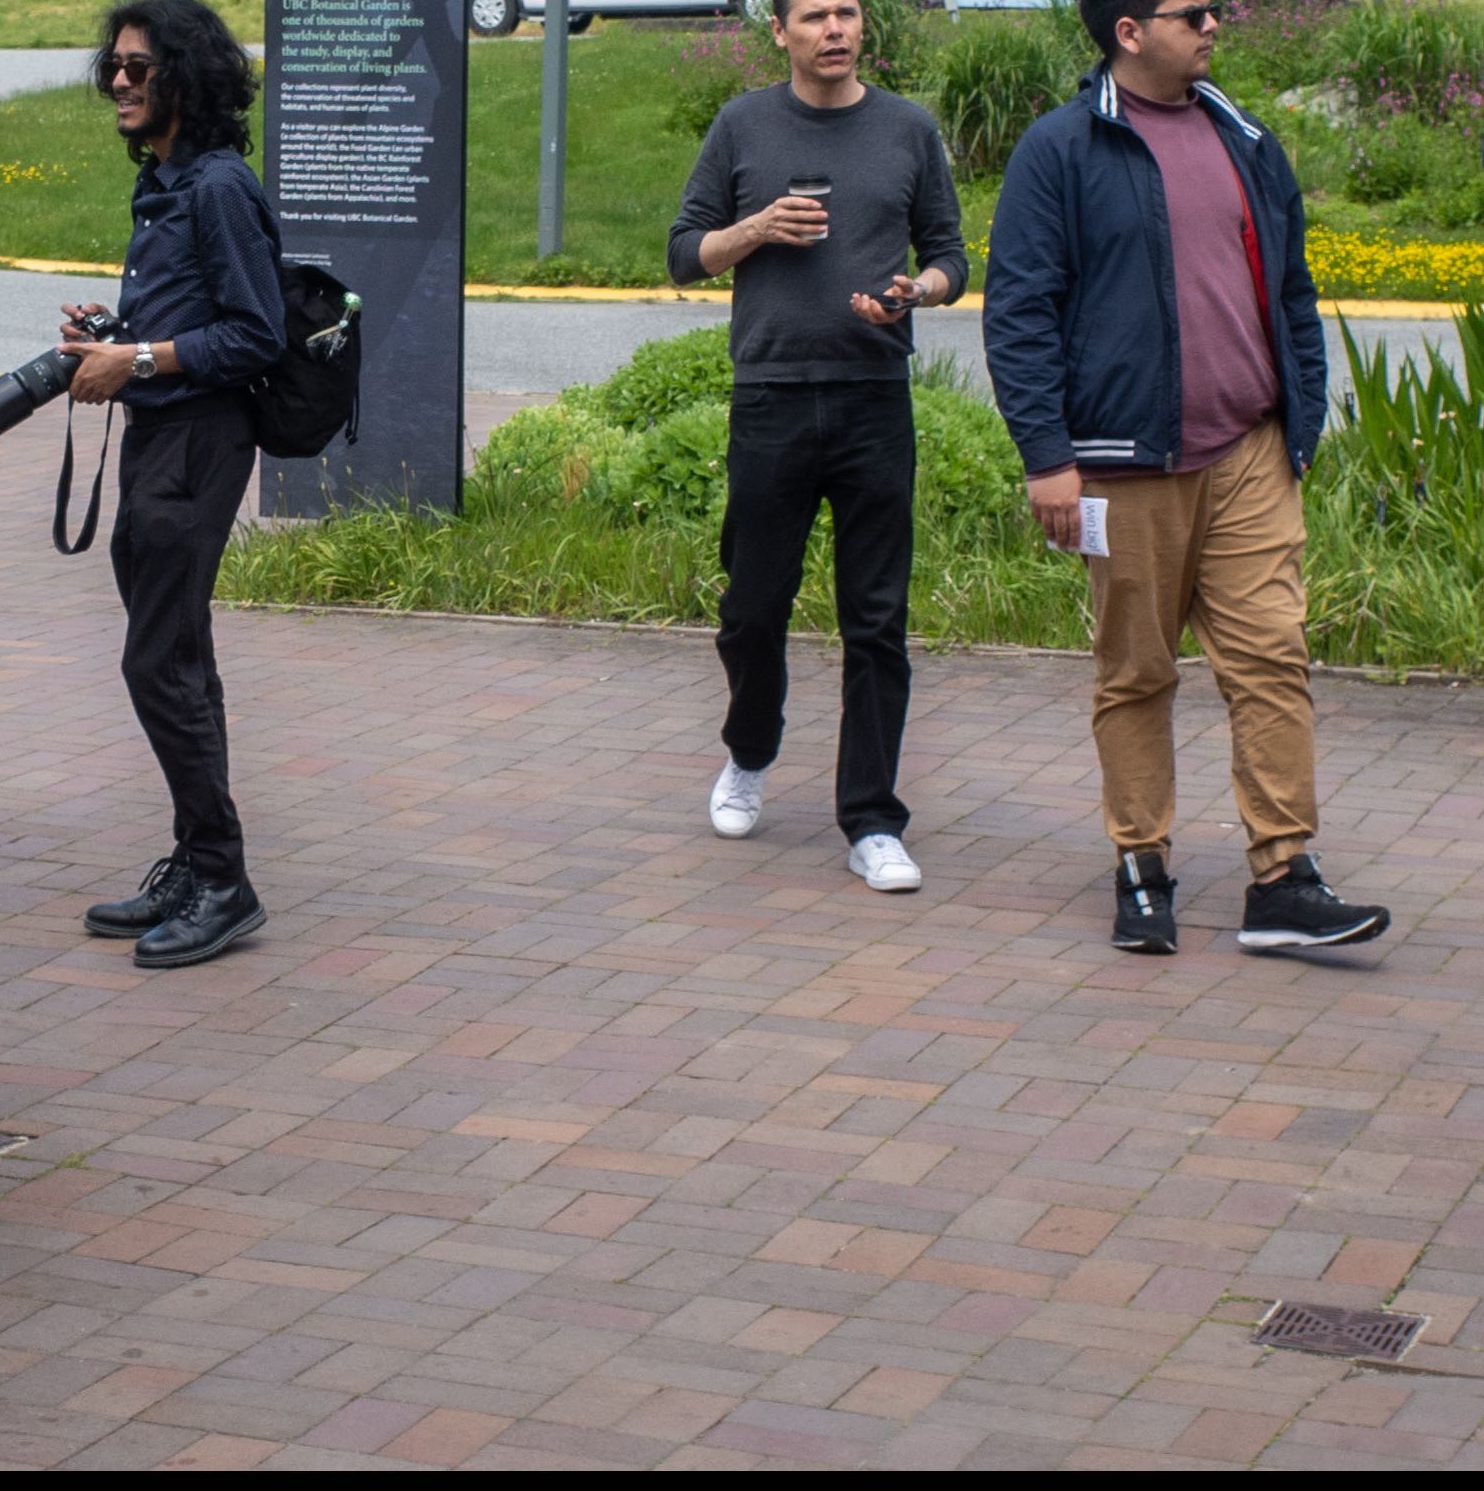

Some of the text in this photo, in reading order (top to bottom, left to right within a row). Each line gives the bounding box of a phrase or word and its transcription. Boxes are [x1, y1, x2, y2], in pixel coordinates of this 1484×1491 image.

[283, 0, 411, 11] UBC Botanical Garden is
[282, 15, 424, 29] one of thousands of gardens
[282, 30, 400, 42] worldwide dedicated to
[282, 46, 392, 60] the study, display, and
[281, 62, 427, 77] conservation of living plants.
[400, 124, 424, 132] Garden
